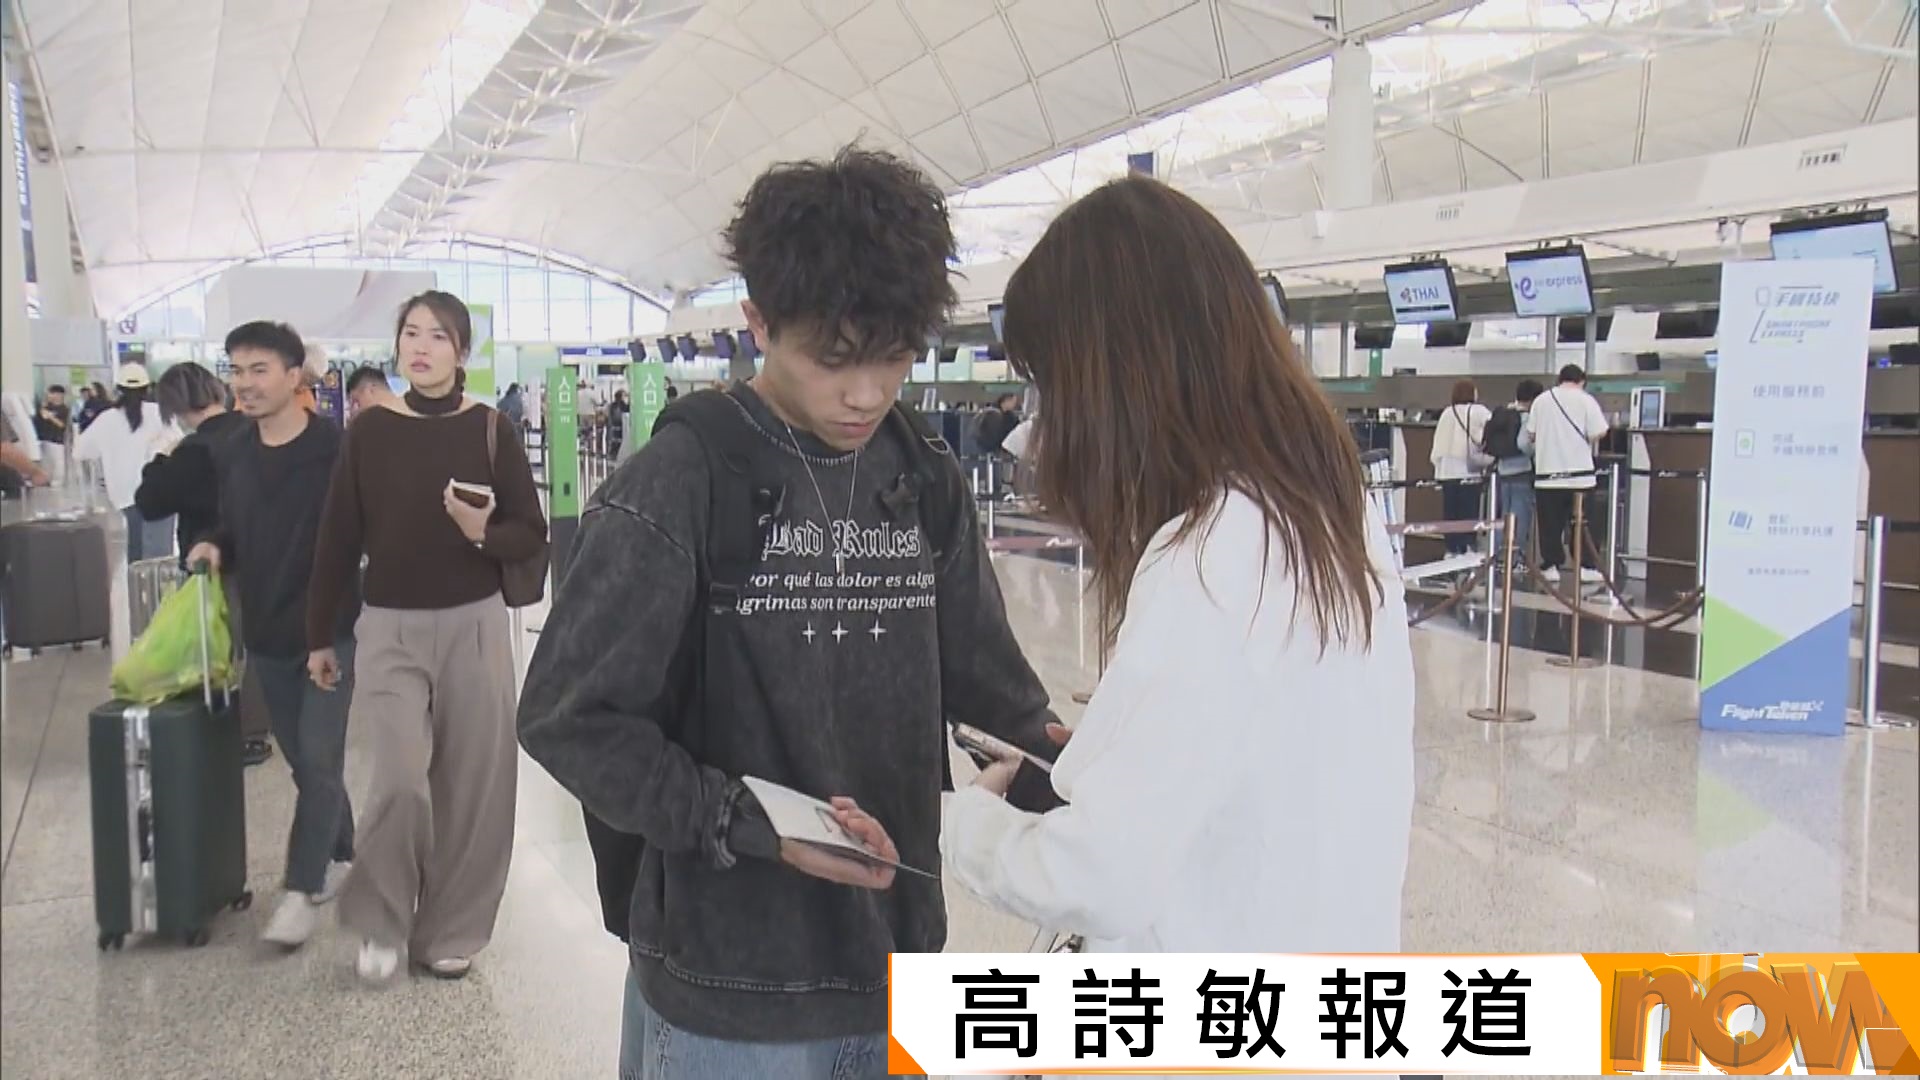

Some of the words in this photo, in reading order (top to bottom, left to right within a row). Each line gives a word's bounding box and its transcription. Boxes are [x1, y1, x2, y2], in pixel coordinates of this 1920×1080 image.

[1546, 275, 1583, 289] express
[1412, 286, 1439, 301] THAI
[558, 375, 571, 404] 入口
[643, 373, 657, 406] 入口
[833, 520, 921, 559] Rules
[784, 570, 811, 592] qué
[815, 572, 834, 588] las
[837, 571, 882, 588] dolor
[885, 574, 902, 588] es
[905, 571, 935, 590] algo
[810, 596, 834, 611] son
